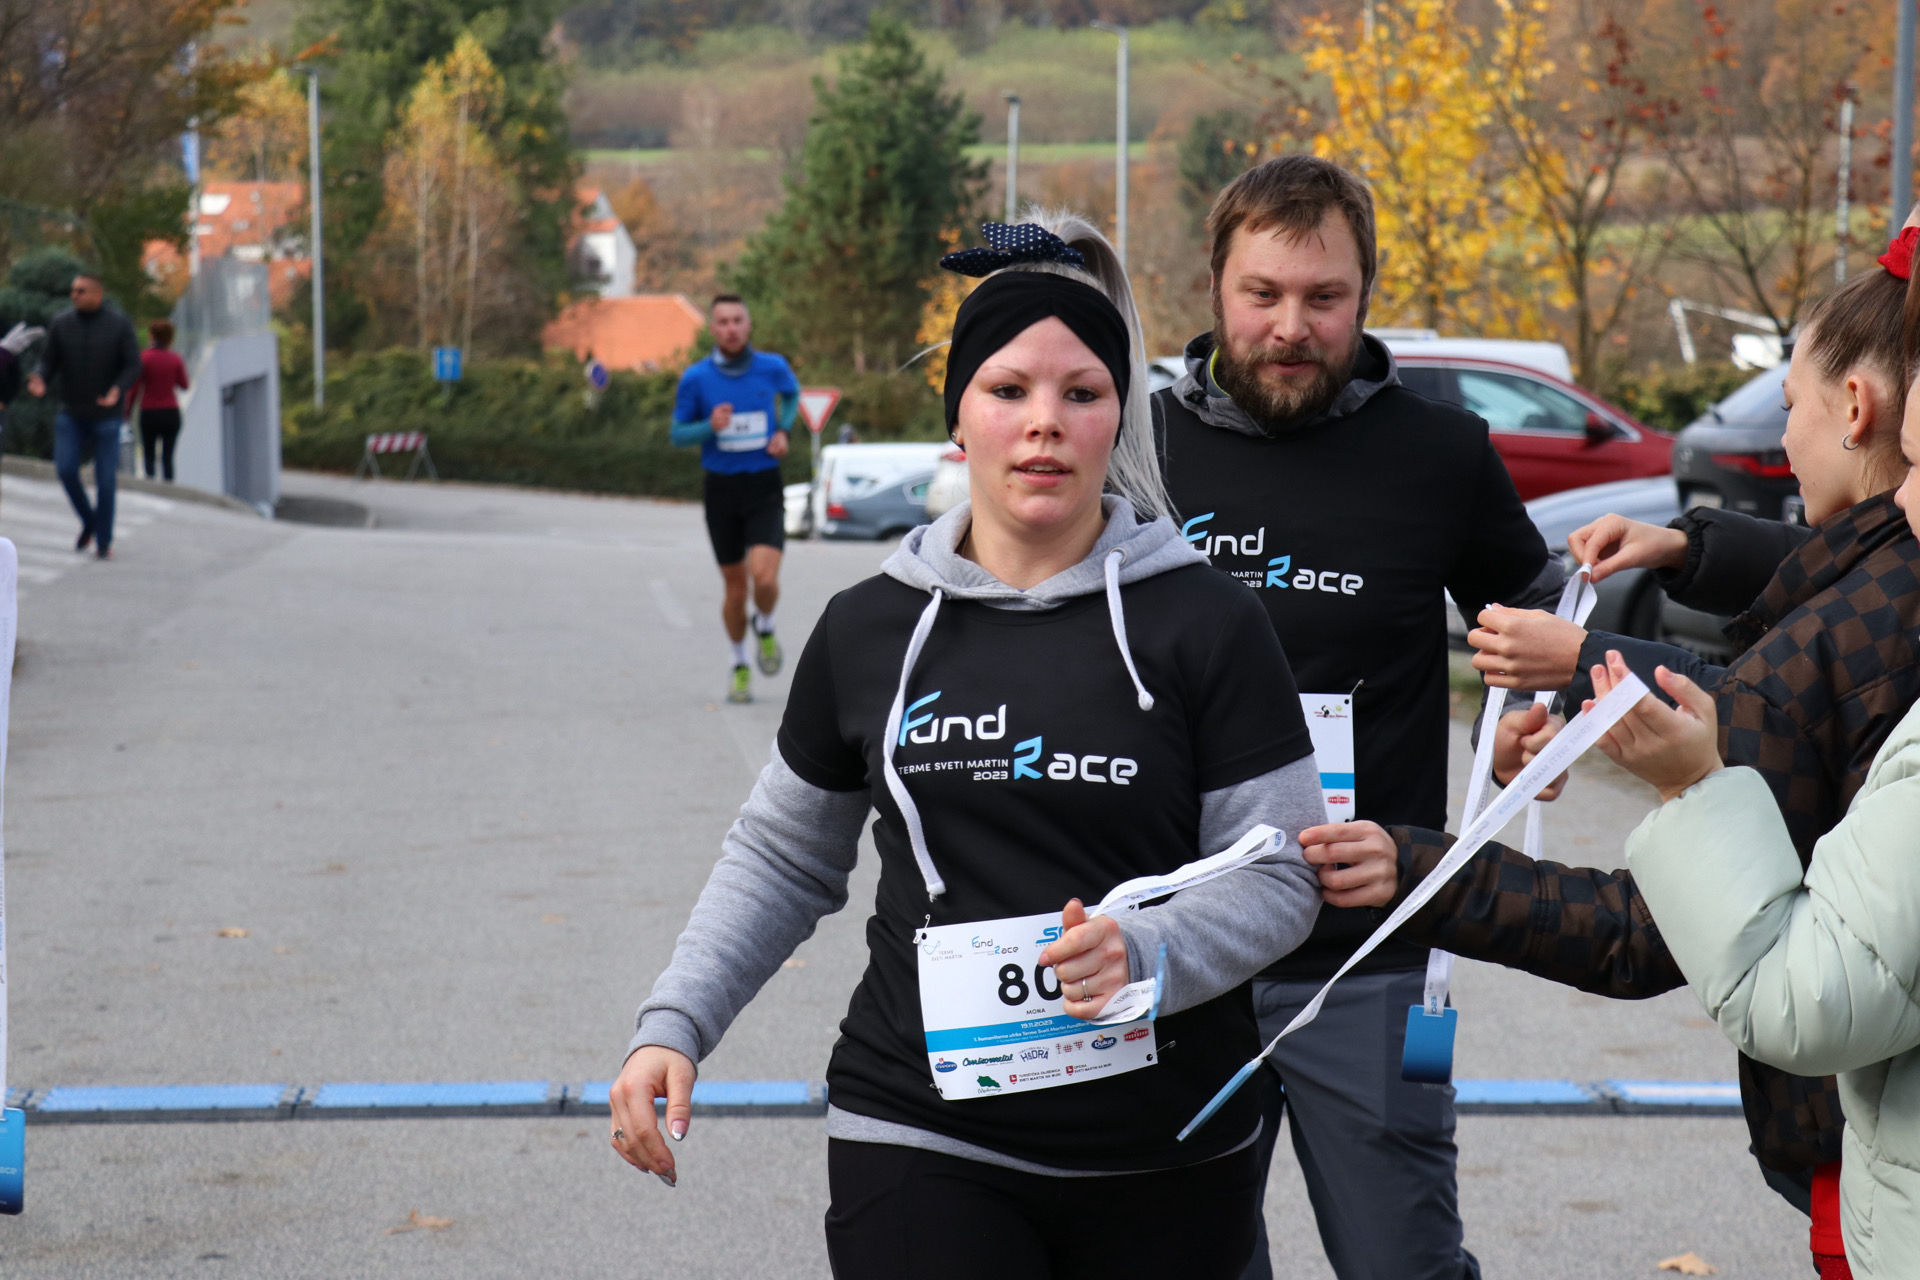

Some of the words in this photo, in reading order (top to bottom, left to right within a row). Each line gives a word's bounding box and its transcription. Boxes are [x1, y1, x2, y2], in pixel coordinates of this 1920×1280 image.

[1181, 512, 1265, 556] Fund
[1231, 571, 1263, 579] MARTIN
[1266, 555, 1364, 595] Race
[898, 690, 1007, 746] Fund
[898, 763, 931, 776] TERME
[934, 761, 964, 771] SVETI
[967, 759, 1009, 769] MARTIN
[1013, 735, 1138, 785] Race
[973, 770, 1008, 781] 2023
[972, 936, 993, 948] Fund
[994, 945, 1019, 955] Race
[998, 963, 1063, 1006] 80
[1094, 1038, 1115, 1048] Dukat
